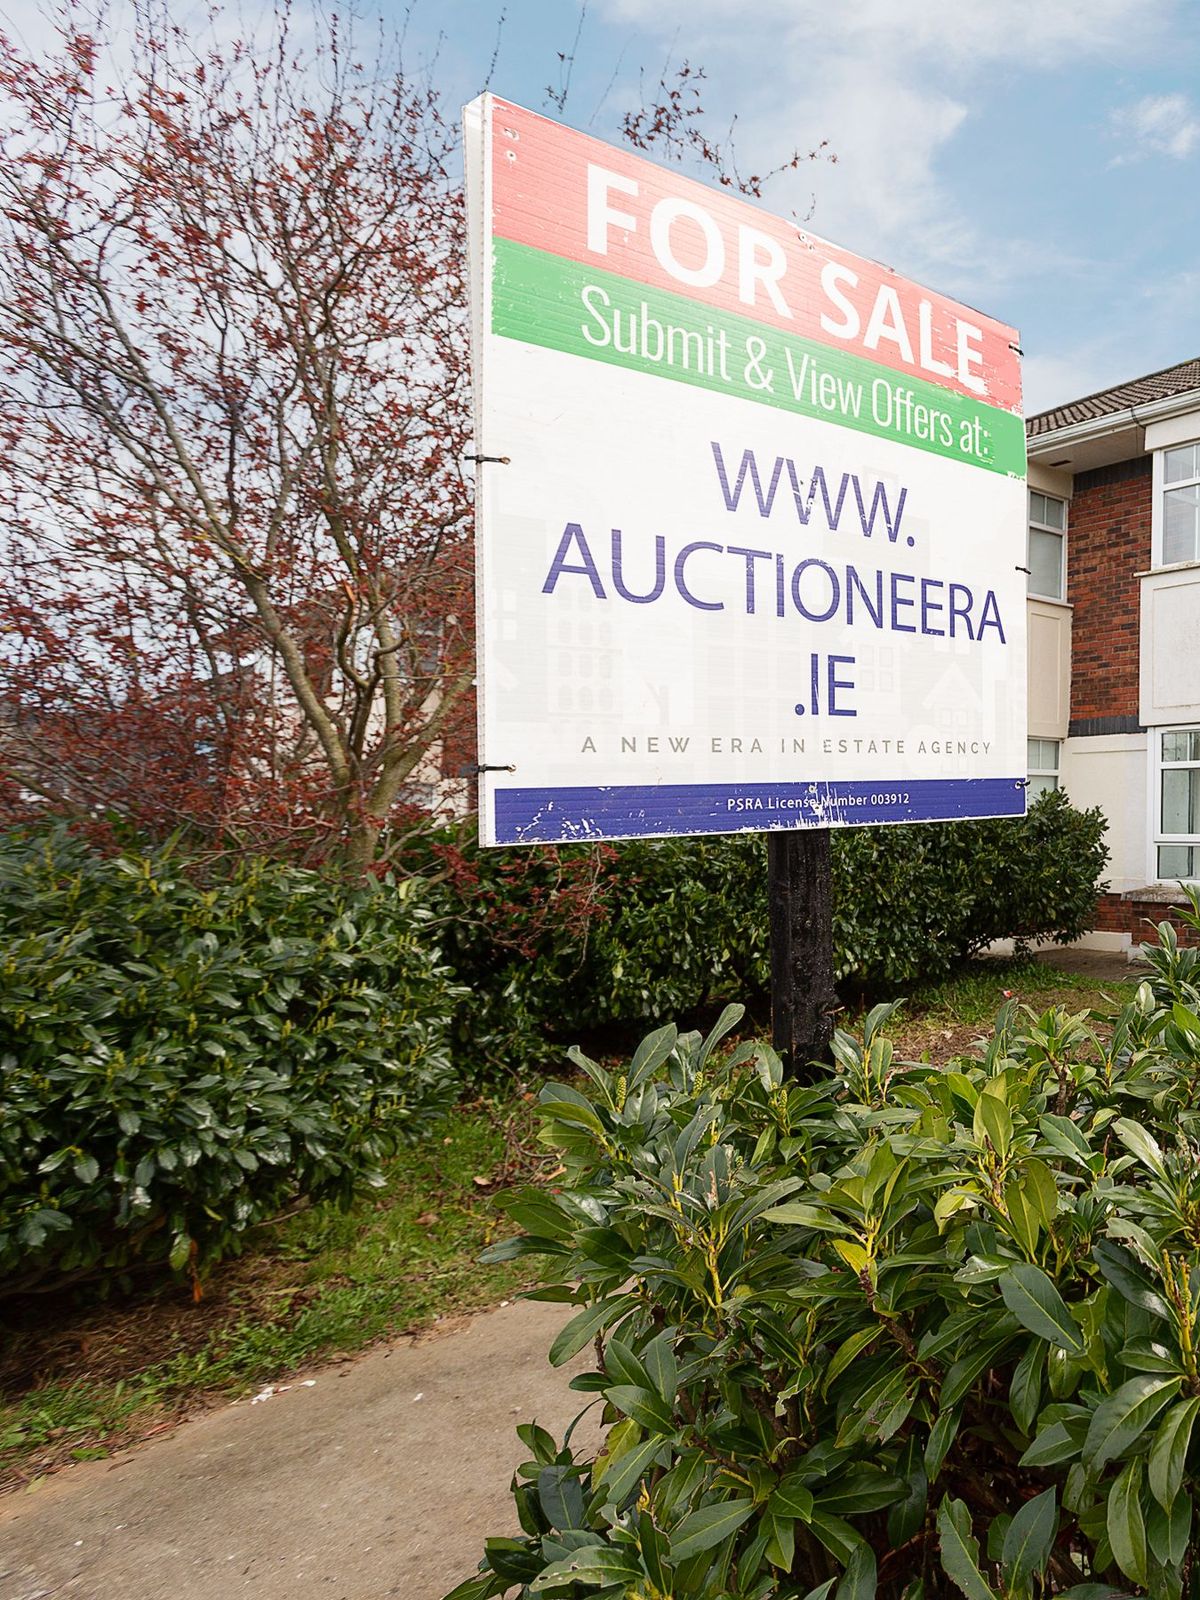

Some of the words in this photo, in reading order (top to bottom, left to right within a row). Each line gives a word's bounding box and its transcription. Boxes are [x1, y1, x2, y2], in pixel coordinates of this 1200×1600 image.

[587, 163, 795, 320] FOR
[820, 262, 989, 396] SALE
[581, 285, 731, 382] Submit
[744, 335, 774, 394] &
[785, 347, 862, 418] View
[872, 378, 953, 447] Offers
[960, 420, 991, 458] at:
[710, 441, 916, 547] WWW.
[541, 522, 1007, 645] AUCTIONEERA
[794, 653, 858, 717] .IE
[581, 736, 597, 753] A
[621, 736, 690, 753] NEW
[711, 737, 763, 753] ERA
[781, 738, 805, 753] IN
[823, 739, 905, 754] ESTATE
[918, 740, 991, 754] AGENCY
[727, 798, 763, 811] PSRA
[768, 795, 816, 809] License
[820, 794, 867, 808] Number
[870, 793, 910, 805] 003912
